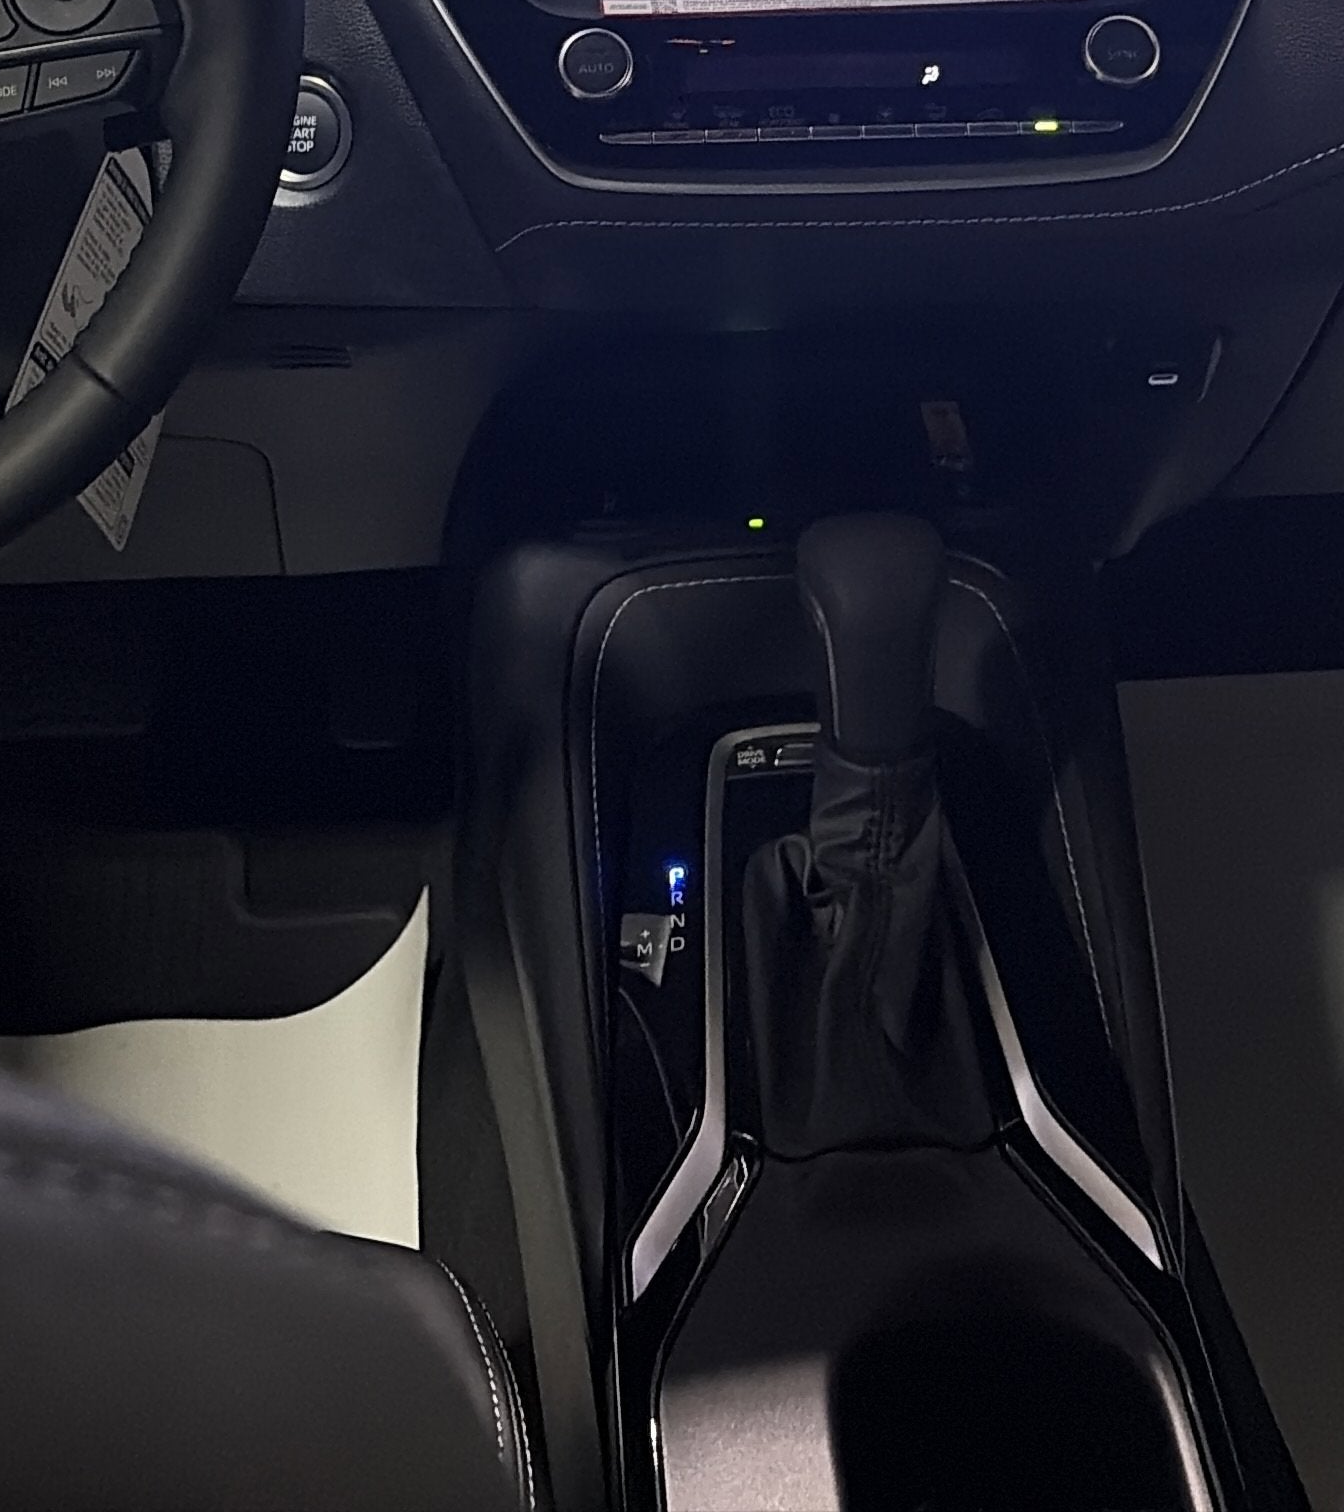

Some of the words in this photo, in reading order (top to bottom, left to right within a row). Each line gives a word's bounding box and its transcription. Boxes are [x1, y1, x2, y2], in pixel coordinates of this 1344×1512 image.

[578, 62, 615, 74] AUTO
[293, 115, 317, 126] GINE
[293, 127, 316, 140] ART
[737, 757, 766, 766] MODE
[669, 866, 684, 885] P
[670, 890, 684, 906] R
[670, 912, 685, 928] N
[637, 941, 653, 957] M
[670, 936, 685, 952] D
